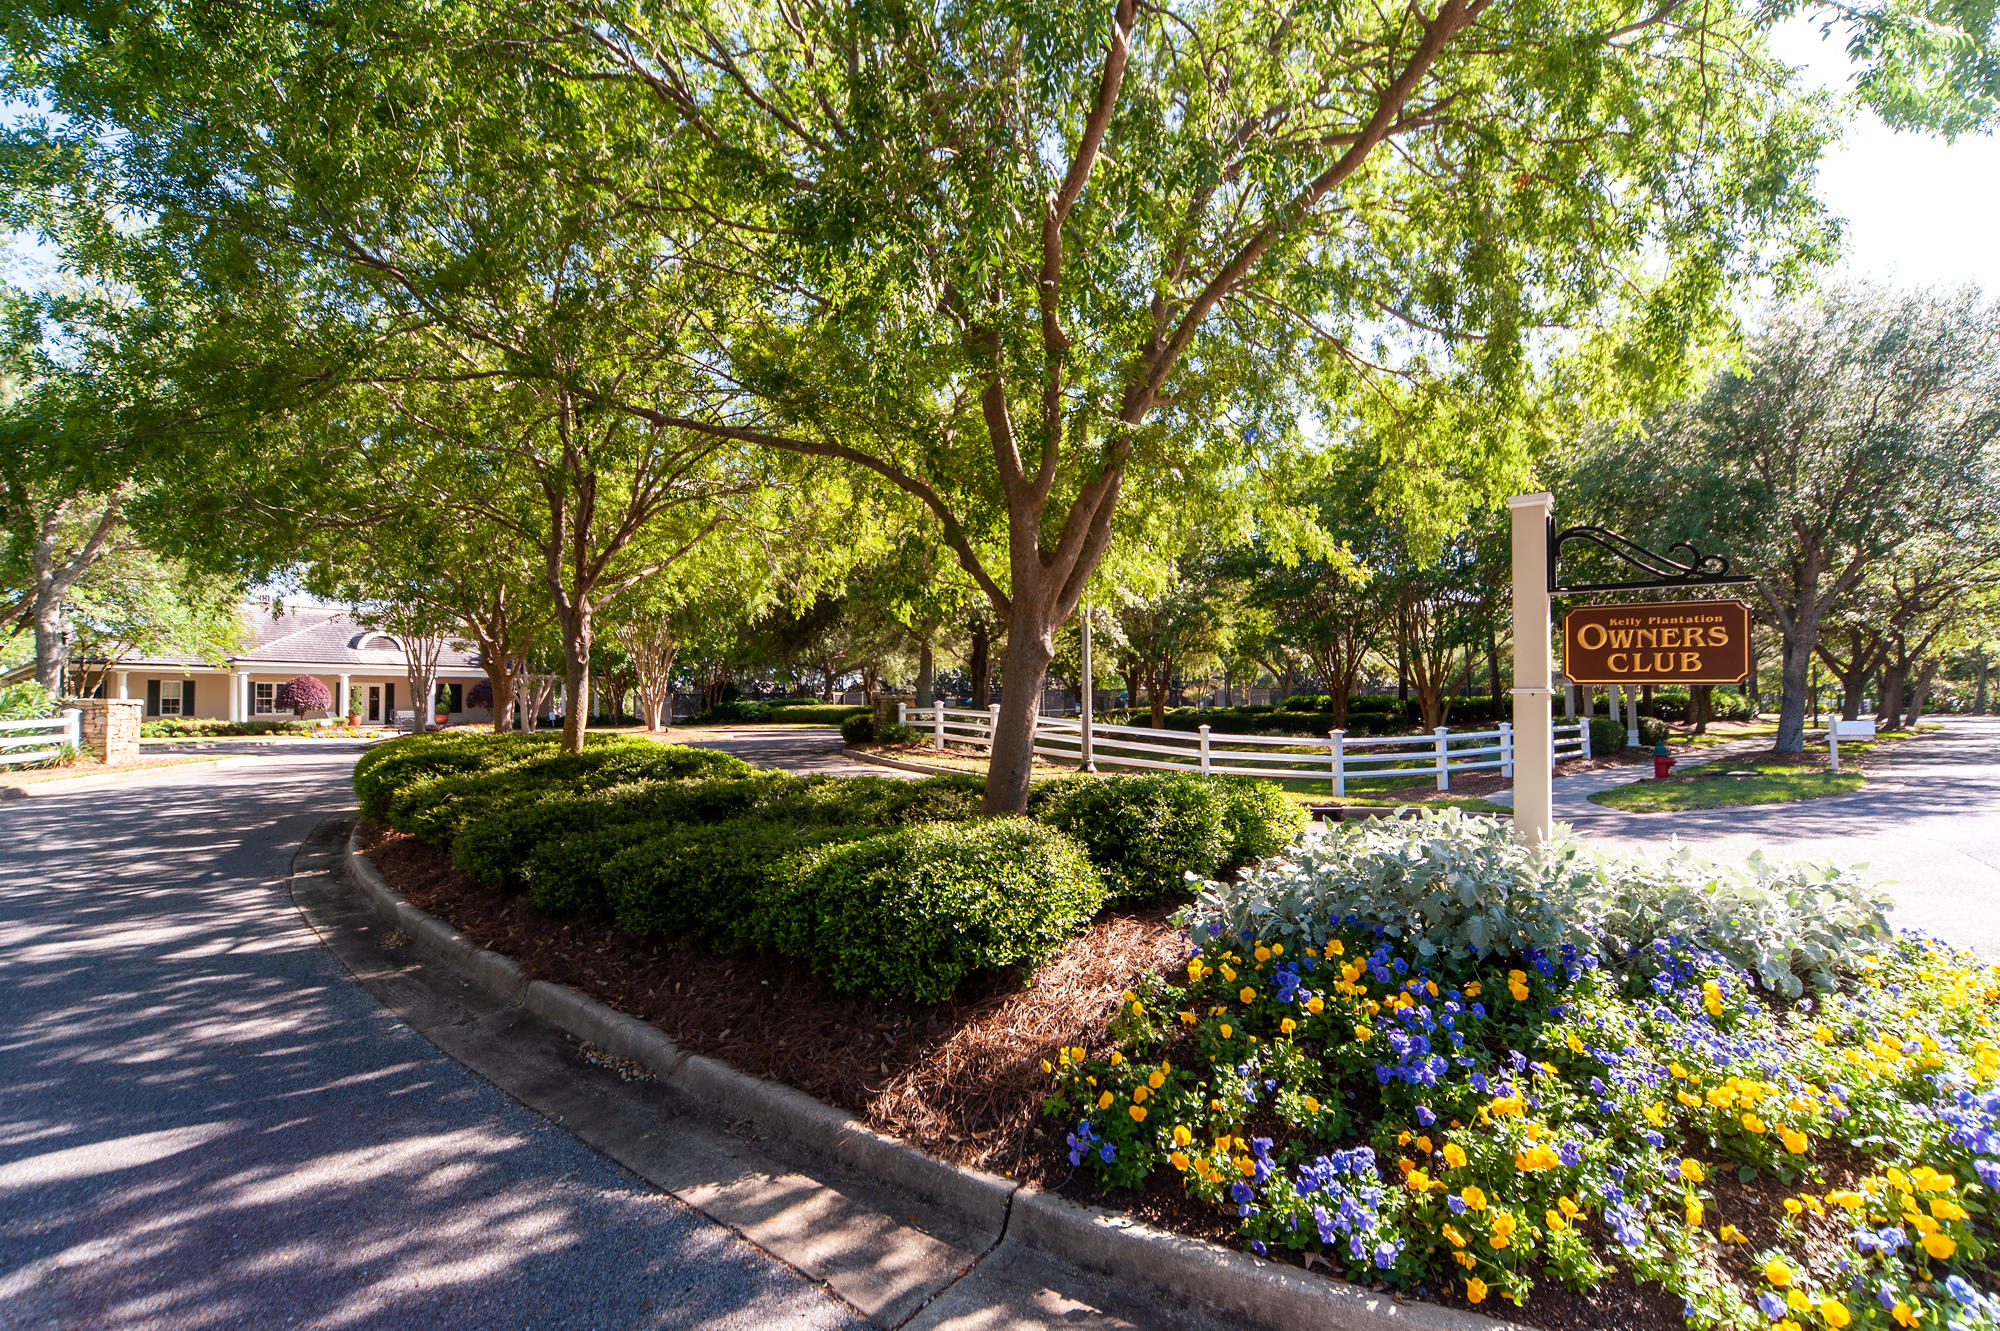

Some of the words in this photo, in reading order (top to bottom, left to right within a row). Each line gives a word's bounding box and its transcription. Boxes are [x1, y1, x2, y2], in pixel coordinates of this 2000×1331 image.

[1609, 617, 1642, 627] Kelly
[1648, 614, 1723, 625] Plantation
[1577, 623, 1729, 650] OWNERS
[1607, 652, 1703, 673] CLUB
